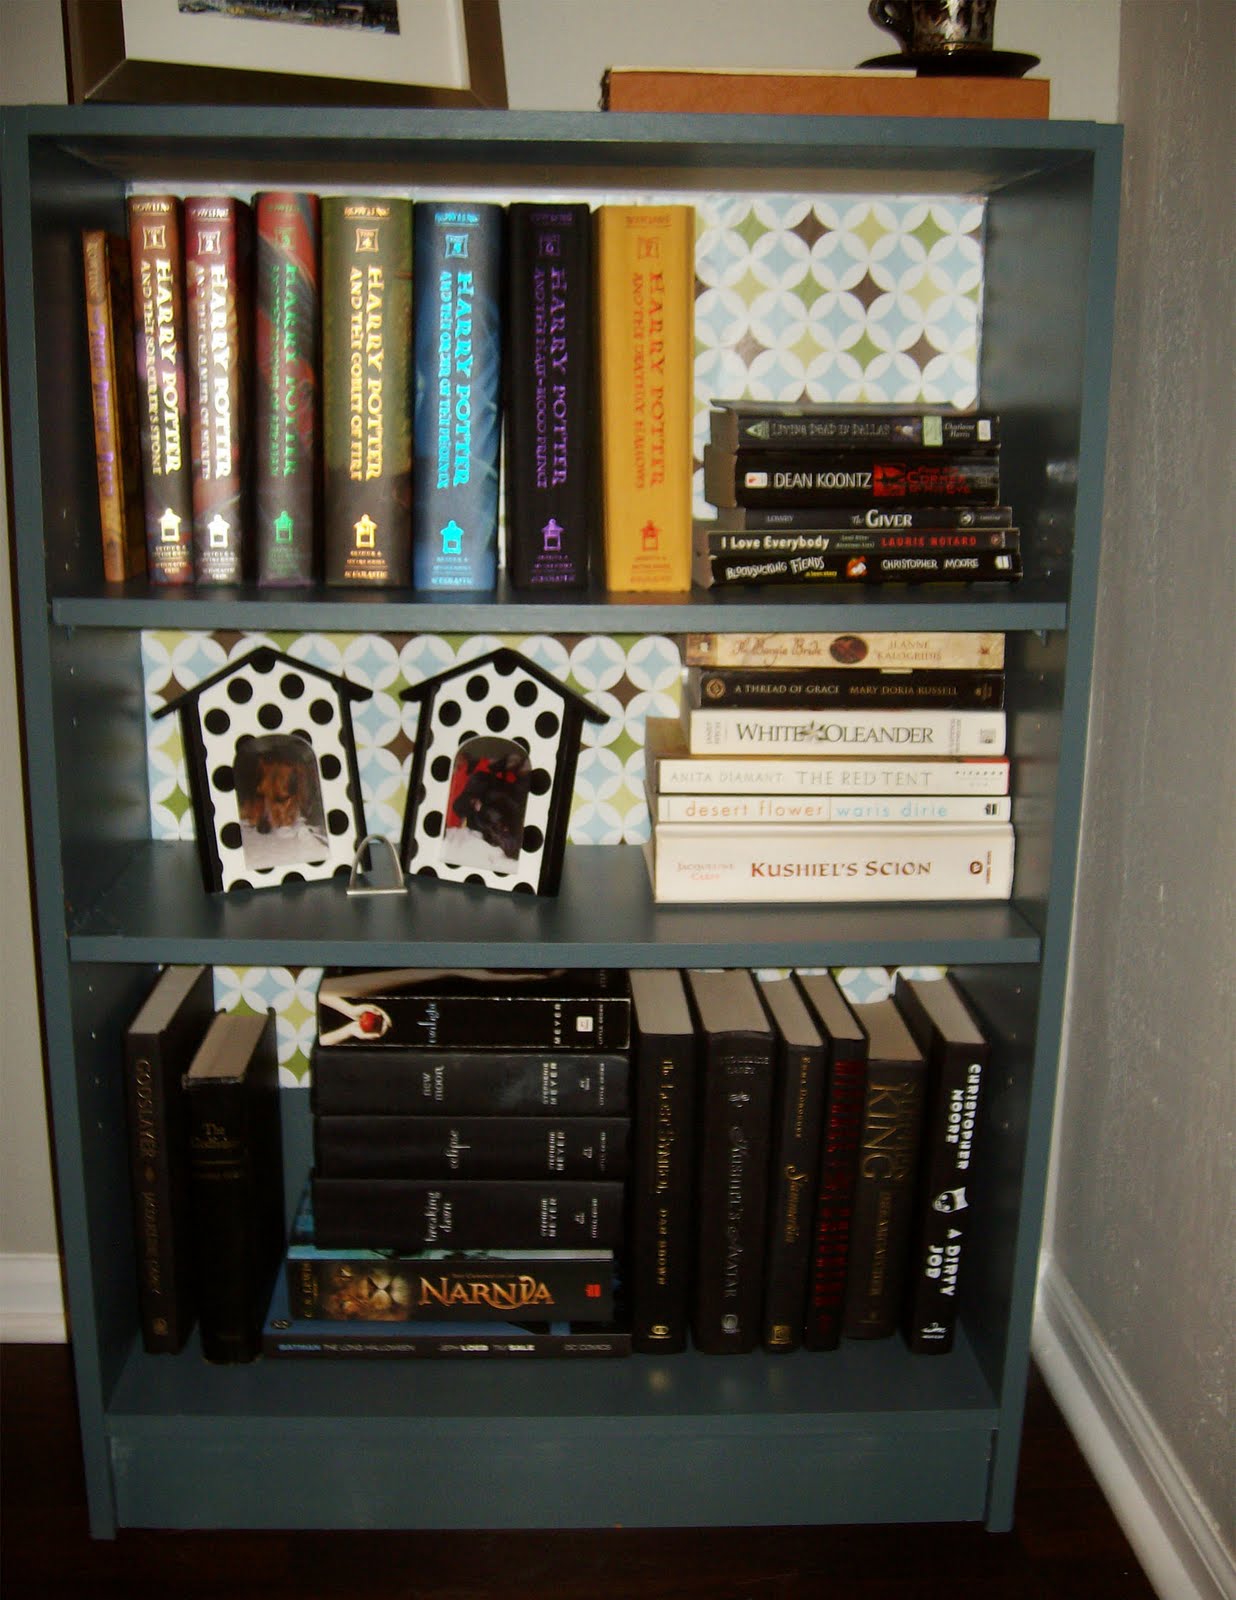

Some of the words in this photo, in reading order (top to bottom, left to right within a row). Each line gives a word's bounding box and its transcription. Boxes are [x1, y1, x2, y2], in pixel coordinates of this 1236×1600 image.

[350, 266, 362, 310] AND
[439, 271, 452, 302] AND
[535, 268, 546, 300] AND
[155, 258, 178, 365] HARRY
[209, 264, 231, 371] HARRY
[283, 264, 299, 367] HARRY
[350, 311, 363, 351] THE
[365, 264, 384, 372] HARRY
[454, 271, 475, 379] HARRY
[550, 267, 569, 375] HARRY
[648, 271, 667, 377] HARRY
[141, 260, 152, 299] AND
[151, 425, 162, 476] STONE
[161, 371, 182, 475] POTTER
[213, 376, 232, 479] POTTER
[283, 374, 299, 477] POTTER
[350, 414, 363, 438] OF
[365, 377, 384, 481] POTTER
[453, 384, 472, 488] POTTER
[551, 384, 568, 488] POTTER
[650, 385, 666, 489] POTTER
[852, 422, 890, 437] DALLAS
[350, 440, 363, 481] FIRE
[536, 436, 548, 489] PRINCE
[773, 472, 813, 489] DEAN
[815, 471, 872, 489] KOONTZ
[766, 514, 794, 523] LOWRY
[865, 508, 914, 529] GIVER
[720, 536, 727, 549] I
[730, 536, 760, 550] Love
[763, 535, 830, 551] Everybody
[881, 536, 925, 547] LAURIE
[930, 536, 977, 547] NOTARO
[725, 560, 788, 580] BLOODSUCKING
[789, 555, 825, 574] FIENDS
[881, 558, 939, 571] CHRISTOPHER
[943, 558, 980, 569] MOORE
[734, 685, 742, 694] A
[744, 684, 787, 694] THREAD
[790, 684, 802, 694] OF
[806, 684, 839, 694] GRACE
[850, 686, 877, 695] MARY
[880, 686, 915, 695] DORIA
[917, 686, 957, 696] RUSSELL
[736, 722, 804, 742] WHITE
[825, 723, 935, 744] OLEANDER
[671, 772, 712, 782] ANITA
[719, 772, 785, 783] DIAMANT
[795, 771, 833, 785] THE
[841, 771, 876, 786] RED
[882, 771, 932, 786] TENT
[685, 800, 749, 817] desert
[759, 799, 823, 817] flower
[837, 801, 890, 817] waris
[900, 800, 949, 818] dirie
[751, 862, 859, 878] KUSHIEL'S
[864, 860, 932, 877] SCION
[416, 1003, 440, 1044] twilight
[553, 1003, 561, 1045] MEYER
[422, 1072, 430, 1096] new
[434, 1065, 446, 1101] moon
[541, 1062, 549, 1105] STEPHENIE
[549, 1062, 558, 1105] MEYER
[861, 1082, 899, 1180] KING
[945, 1088, 964, 1145] MOORE
[956, 1063, 982, 1171] CHRISTOPHER
[446, 1130, 471, 1169] eclipse
[556, 1131, 565, 1170] MEYER
[423, 1192, 441, 1242] breaking
[439, 1201, 452, 1233] dawn
[540, 1198, 548, 1237] STEPHENIE
[548, 1198, 557, 1238] MEYER
[659, 1209, 668, 1235] DAN
[946, 1228, 963, 1239] A
[657, 1239, 668, 1286] BROWN
[925, 1244, 944, 1280] JOB
[940, 1245, 962, 1297] DIRTY
[417, 1275, 556, 1311] NARNIA
